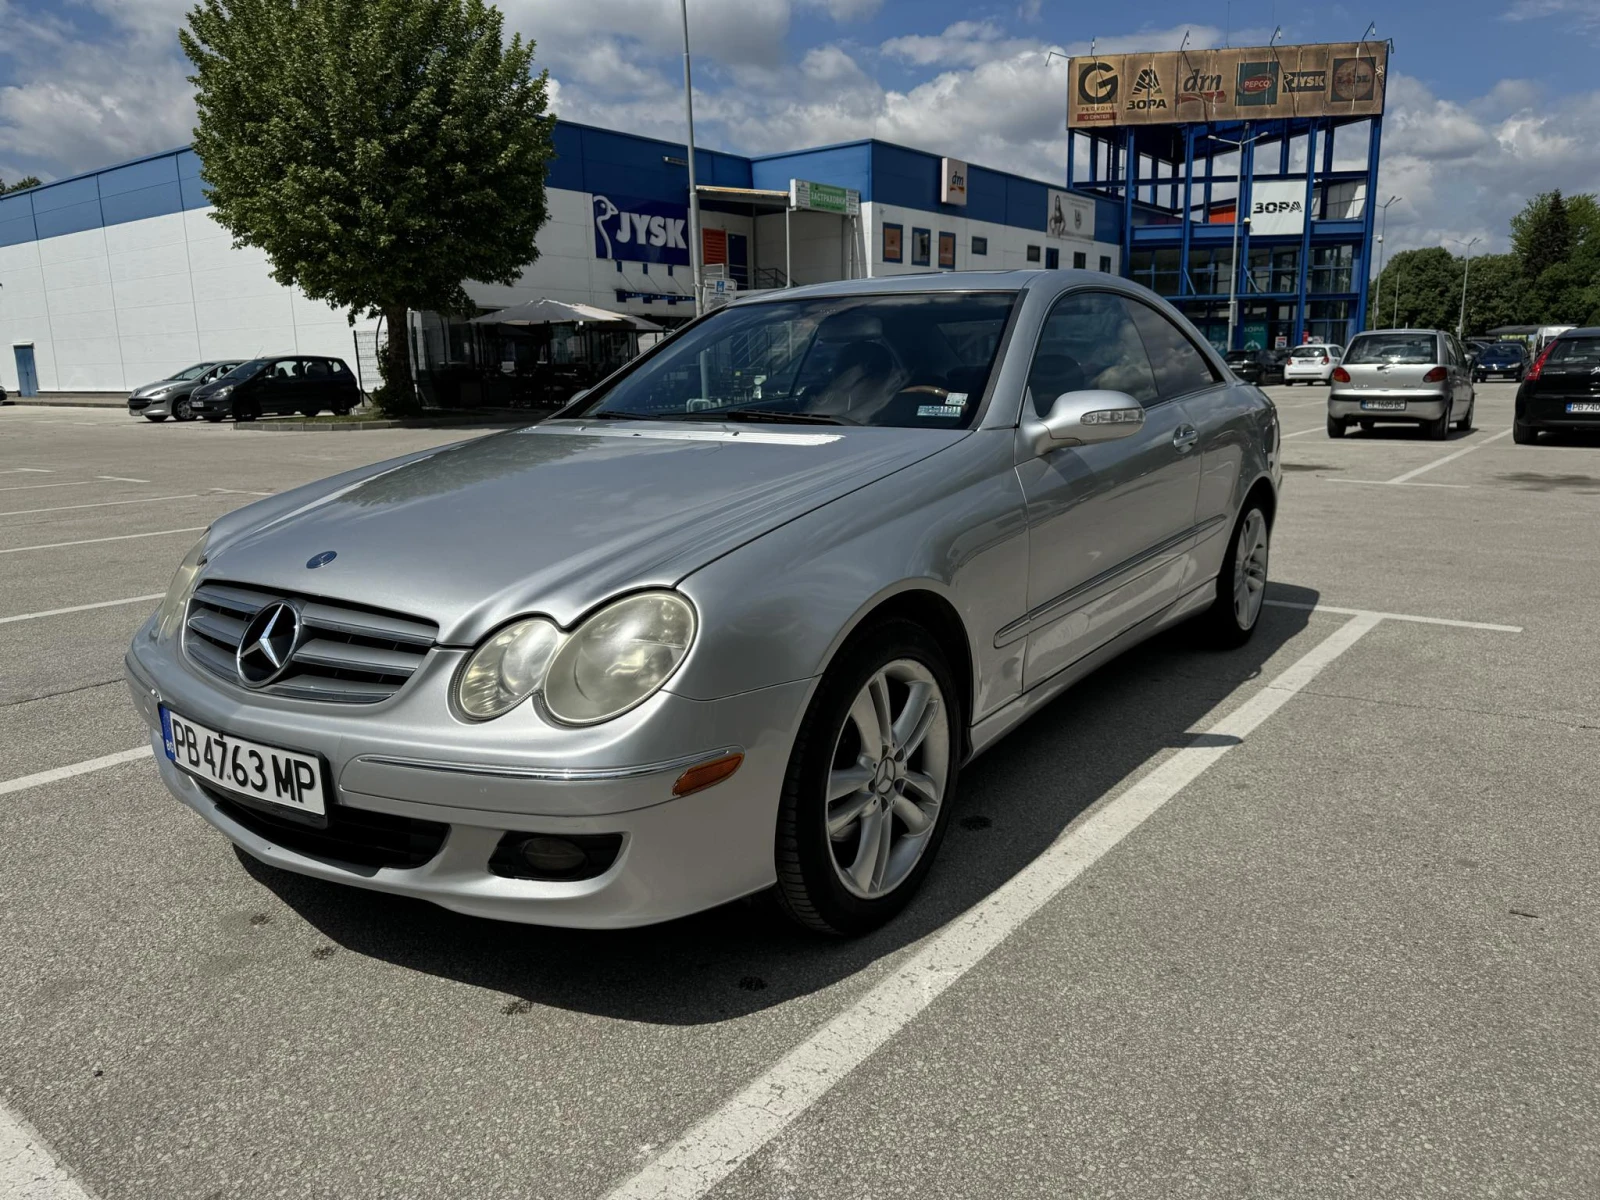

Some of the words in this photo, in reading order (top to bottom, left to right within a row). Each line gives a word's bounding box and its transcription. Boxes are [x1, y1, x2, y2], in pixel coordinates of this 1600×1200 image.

[1183, 68, 1222, 92] dm
[1244, 79, 1270, 88] PEPCO
[1291, 75, 1325, 88] JYSK
[1126, 98, 1167, 110] ЗОРА
[951, 170, 964, 187] dm
[1252, 201, 1302, 214] ЗОРА
[615, 211, 688, 249] JYSK
[172, 718, 200, 767] PB
[203, 735, 267, 792] 4763
[271, 754, 316, 803] MP
